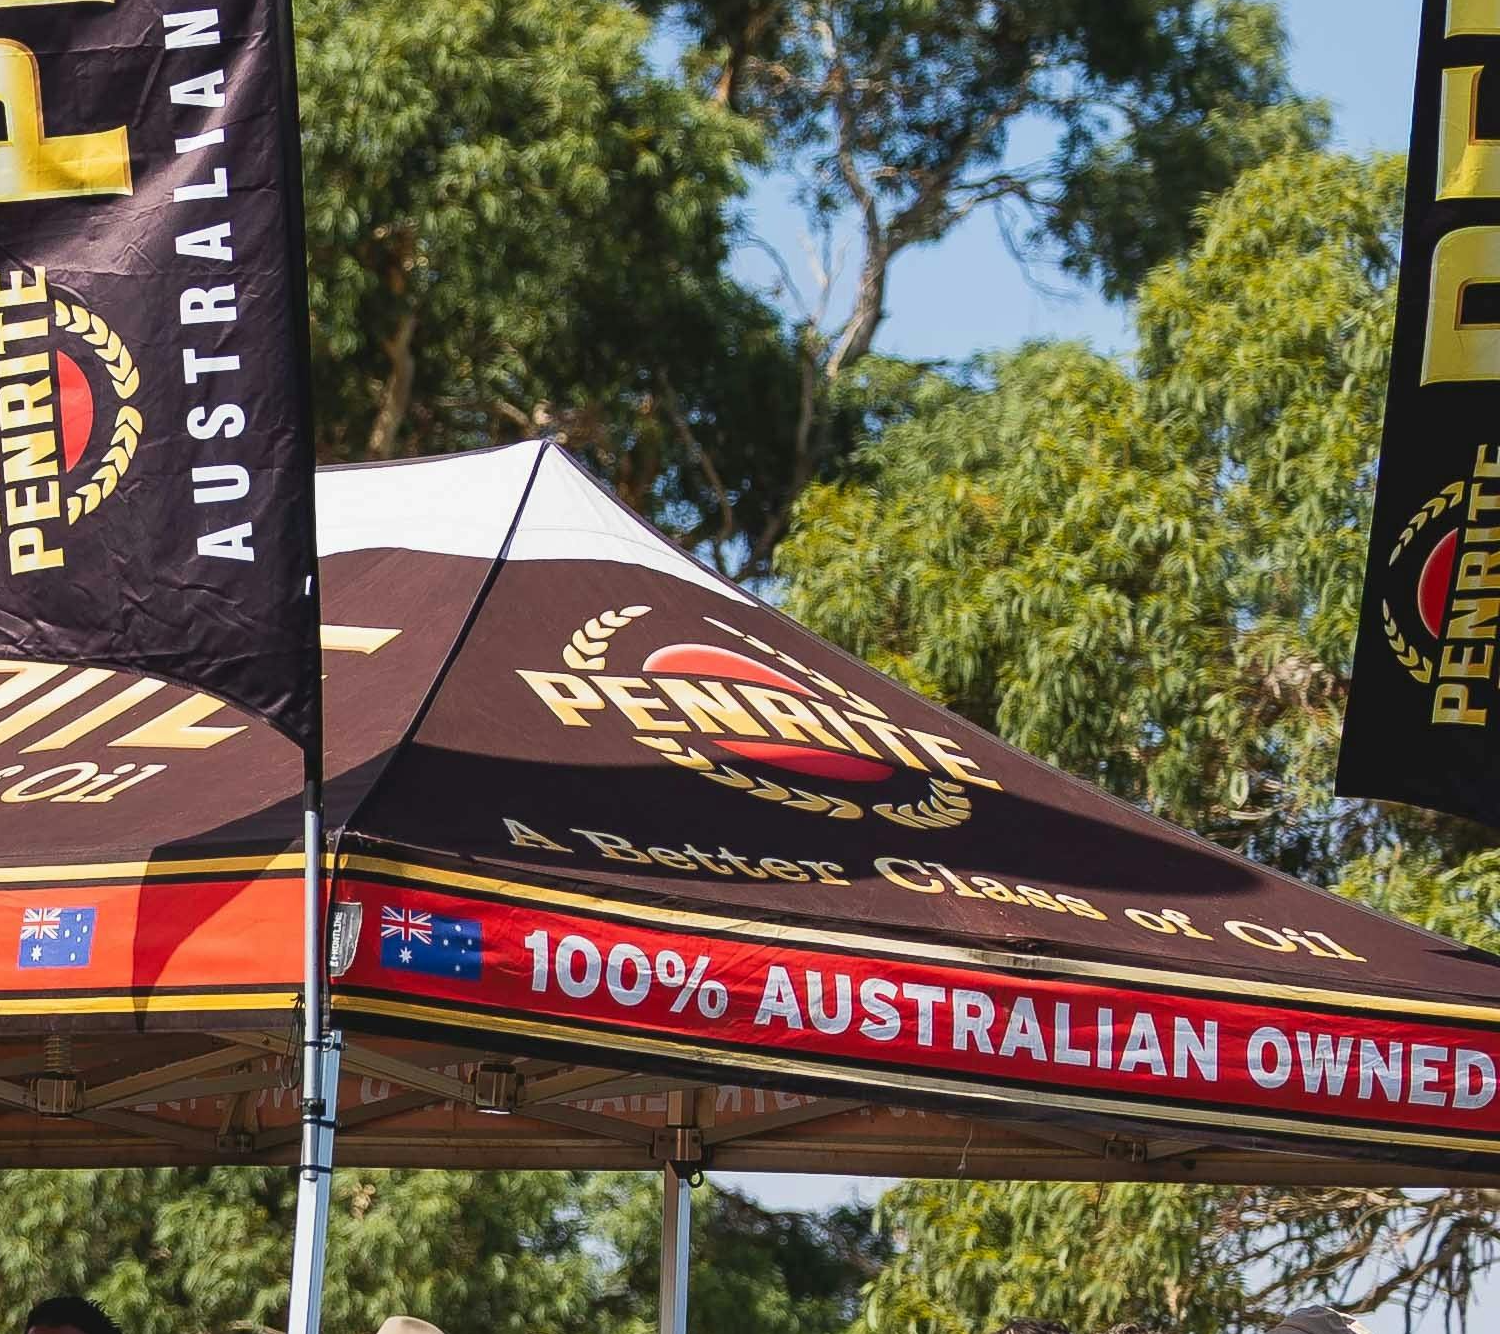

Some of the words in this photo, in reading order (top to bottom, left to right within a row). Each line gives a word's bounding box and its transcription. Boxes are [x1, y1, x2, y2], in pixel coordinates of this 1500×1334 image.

[162, 6, 256, 564] AUSTRALIAN
[0, 760, 169, 804] Oil
[513, 669, 1005, 792] PENRITE
[501, 817, 574, 855] A
[570, 827, 853, 887] Better
[872, 855, 1109, 923] Class
[1123, 906, 1215, 942] of
[1222, 918, 1369, 964] Oil
[523, 929, 732, 1021] 100%
[752, 965, 1220, 1083] AUSTRALIAN
[1245, 1025, 1500, 1110] OWNED
